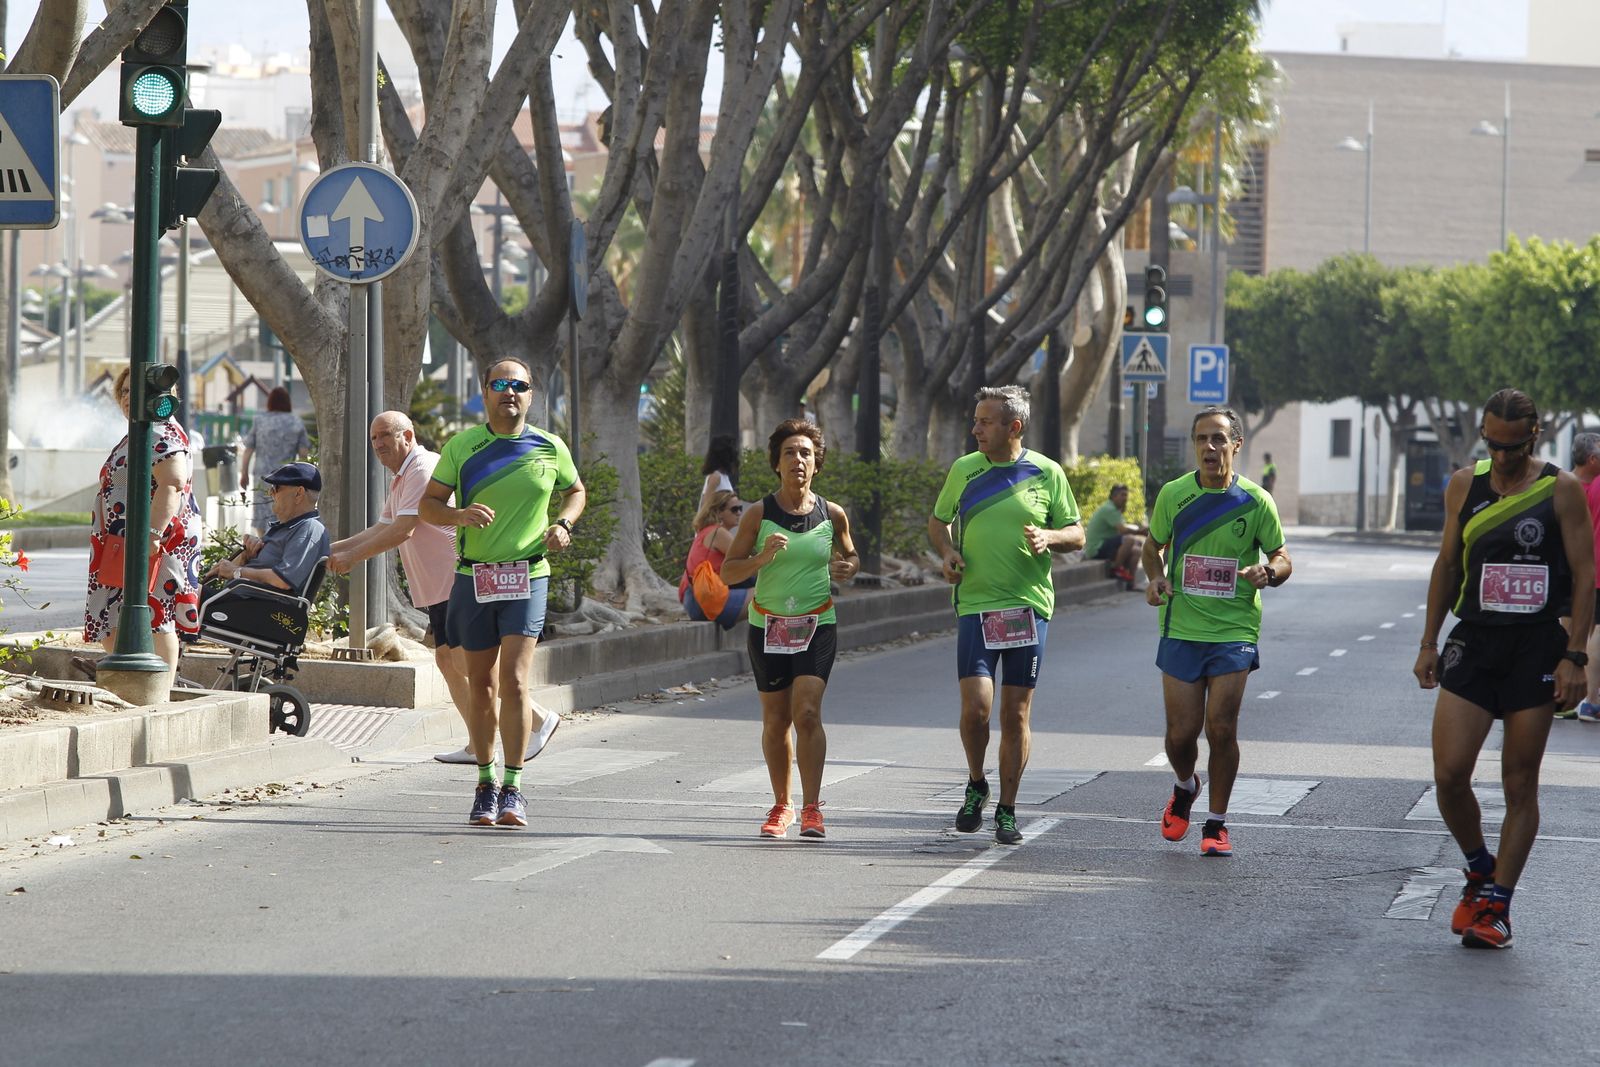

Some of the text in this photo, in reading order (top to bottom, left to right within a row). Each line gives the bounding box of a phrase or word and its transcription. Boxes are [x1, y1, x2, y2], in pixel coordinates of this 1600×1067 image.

[1194, 350, 1216, 383] P
[491, 573, 526, 585] 1087
[1205, 568, 1231, 582] 198
[1501, 578, 1544, 594] 1116
